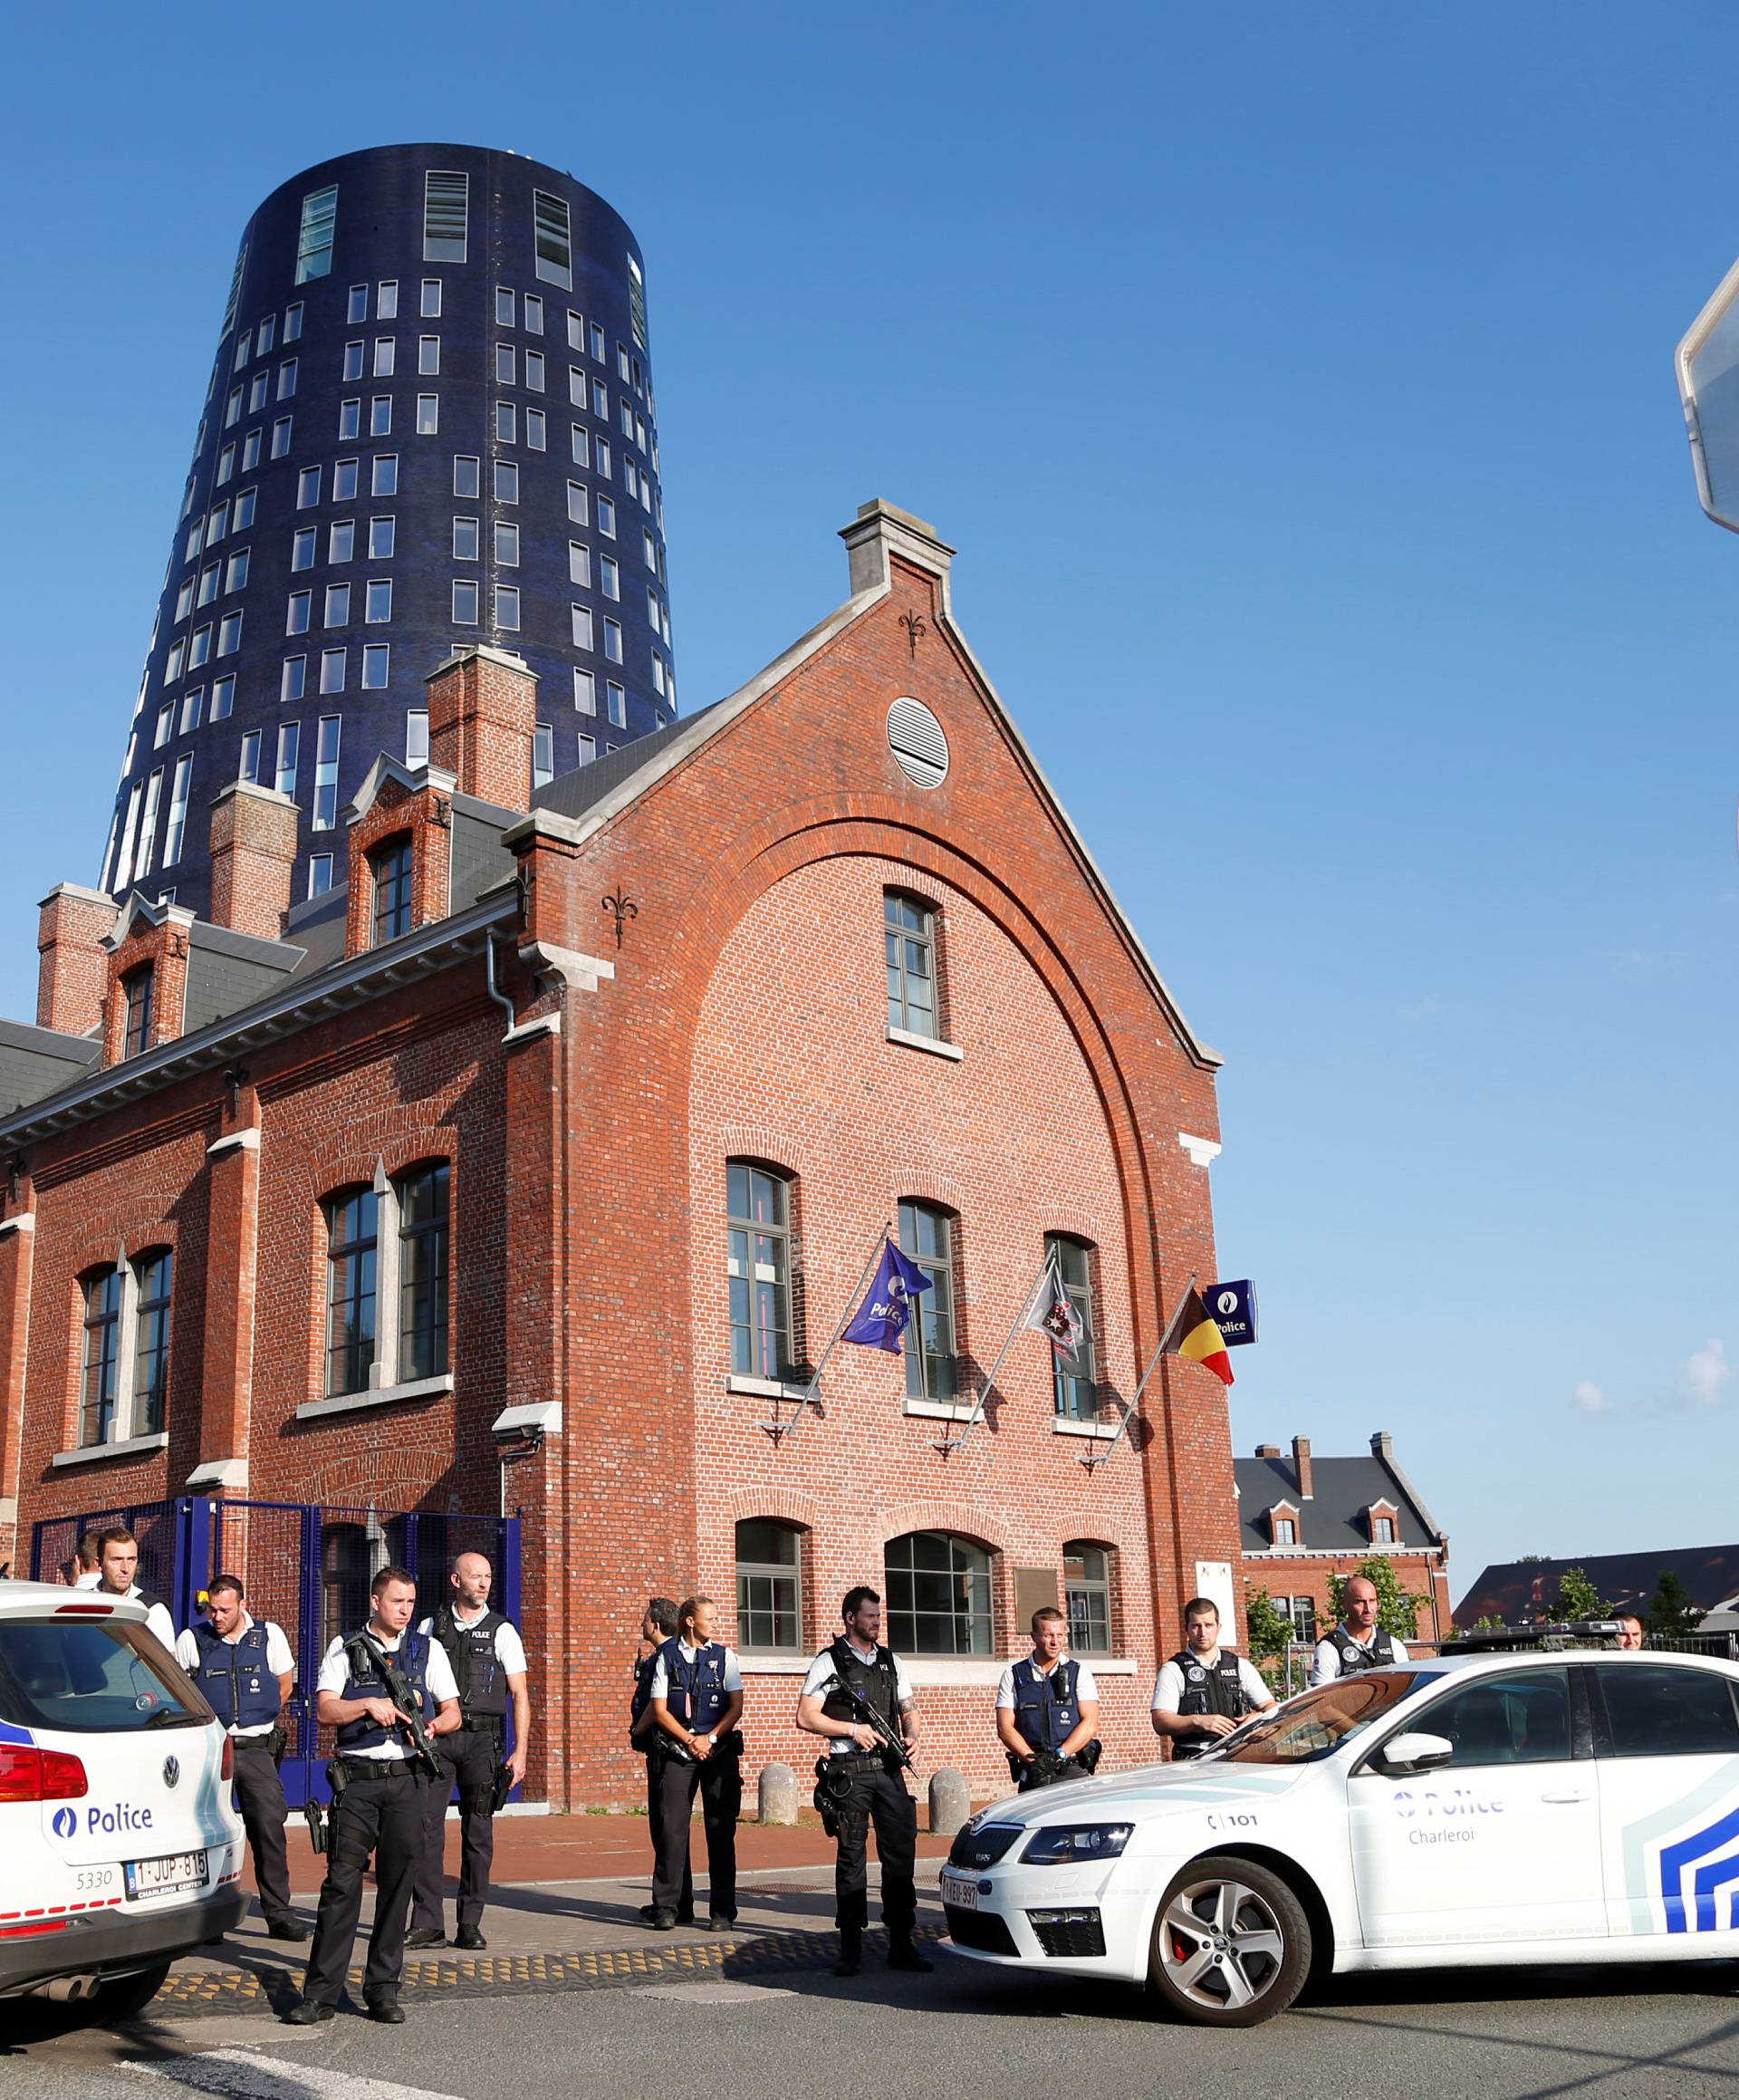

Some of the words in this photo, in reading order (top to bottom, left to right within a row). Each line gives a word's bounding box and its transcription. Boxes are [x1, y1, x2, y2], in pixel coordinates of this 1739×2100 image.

[471, 1631, 491, 1639] POLICE
[1220, 1668, 1238, 1677] POLICE
[88, 1802, 153, 1835] Police
[1227, 1815, 1258, 1826] 101
[1409, 1826, 1475, 1845] Charleroi
[76, 1870, 113, 1891] 5330
[130, 1878, 136, 1889] B
[138, 1885, 177, 1899] CHARLEROI
[178, 1880, 203, 1892] CENTER
